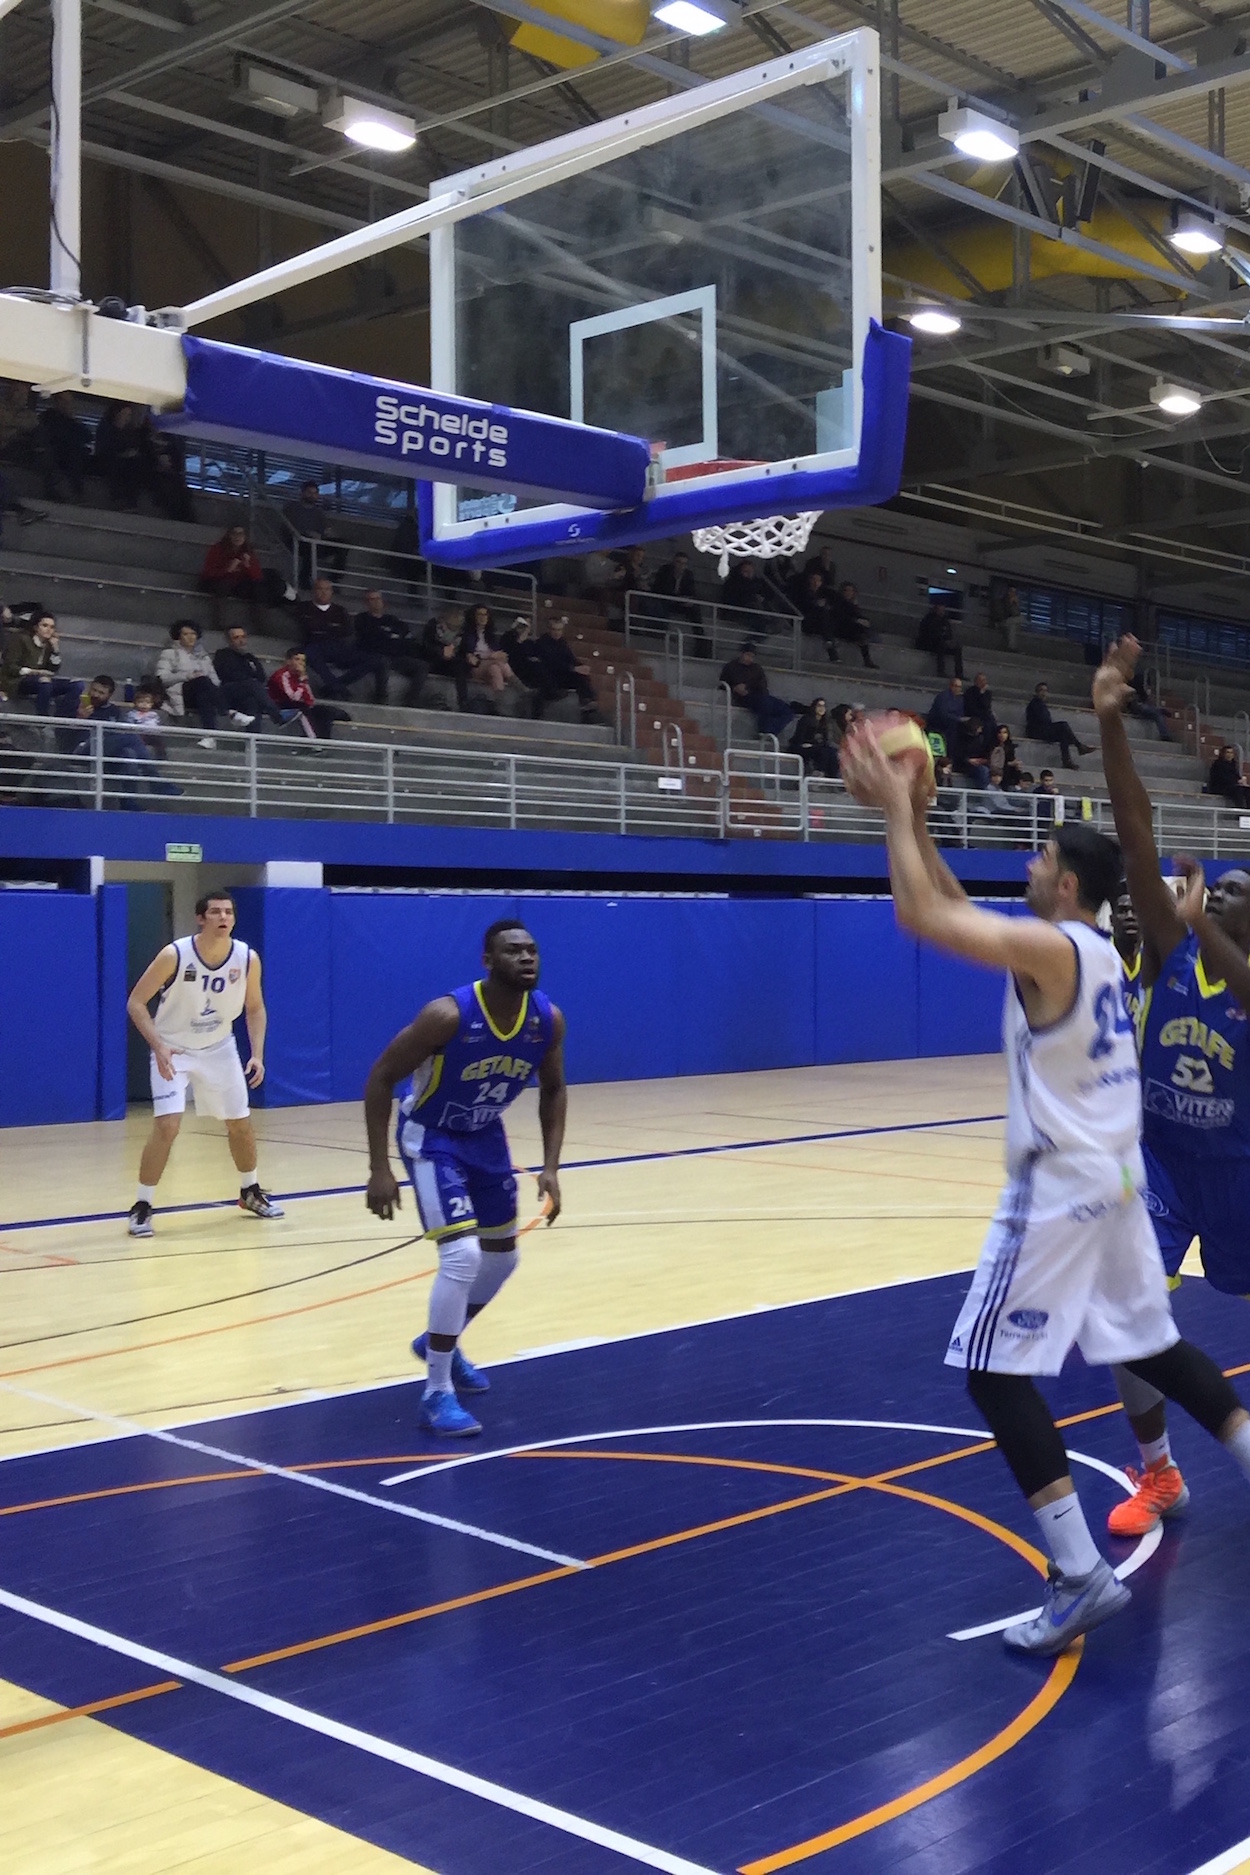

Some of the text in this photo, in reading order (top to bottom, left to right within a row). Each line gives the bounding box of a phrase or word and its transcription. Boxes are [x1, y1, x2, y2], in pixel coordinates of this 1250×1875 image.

[375, 395, 508, 445] Schelde
[374, 420, 507, 467] Sports
[201, 974, 226, 993] 10
[1159, 1016, 1236, 1071] GETAFE
[472, 1081, 510, 1105] 24
[1170, 1053, 1215, 1094] 52
